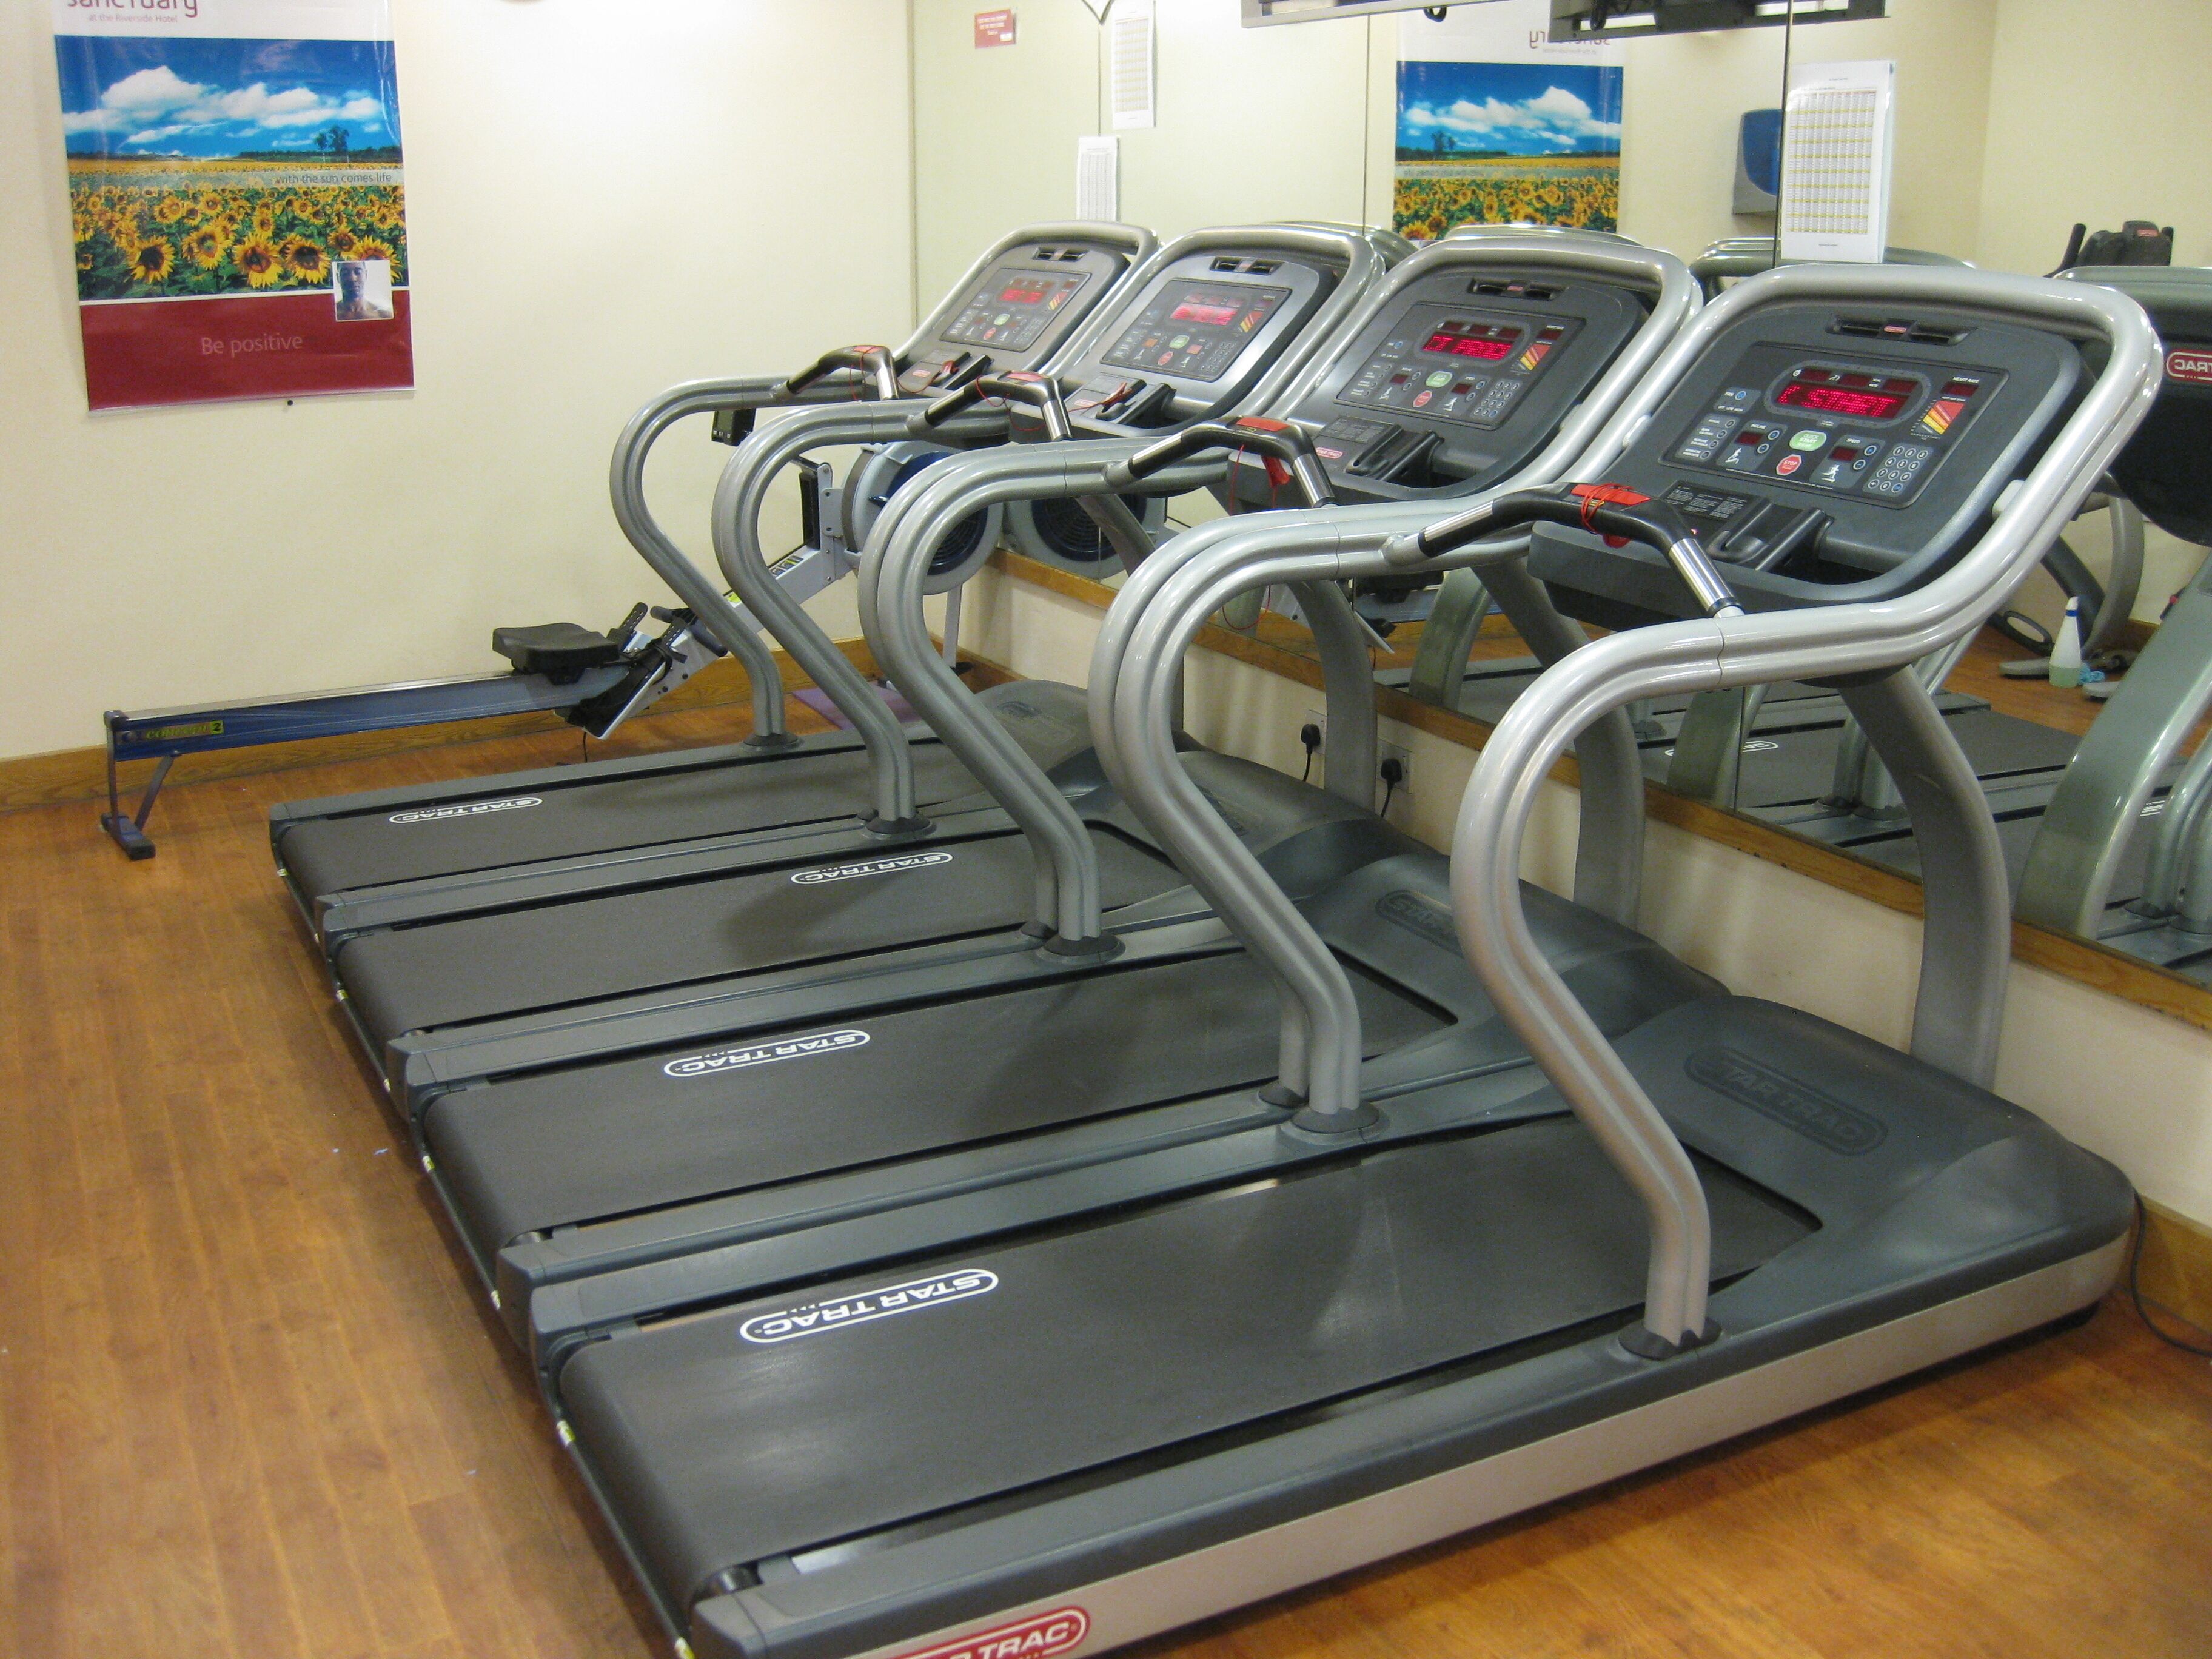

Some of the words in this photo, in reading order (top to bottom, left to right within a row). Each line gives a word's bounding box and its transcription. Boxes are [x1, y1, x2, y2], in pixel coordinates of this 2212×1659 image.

[275, 173, 298, 184] with
[301, 173, 318, 183] the
[321, 175, 339, 184] sun
[341, 174, 373, 183] comes
[376, 172, 392, 182] life
[201, 337, 224, 355] Be
[231, 333, 303, 358] positive
[214, 722, 223, 731] 2
[402, 808, 469, 822] TRAC
[472, 799, 533, 813] STAR
[878, 855, 942, 870] STAR
[805, 867, 876, 881] TRAC
[775, 1034, 856, 1055] STAR
[682, 1050, 771, 1072] TRAC
[880, 1277, 981, 1308] STAR
[762, 1304, 876, 1335] TRAC
[977, 1621, 1070, 1659] TRAC
